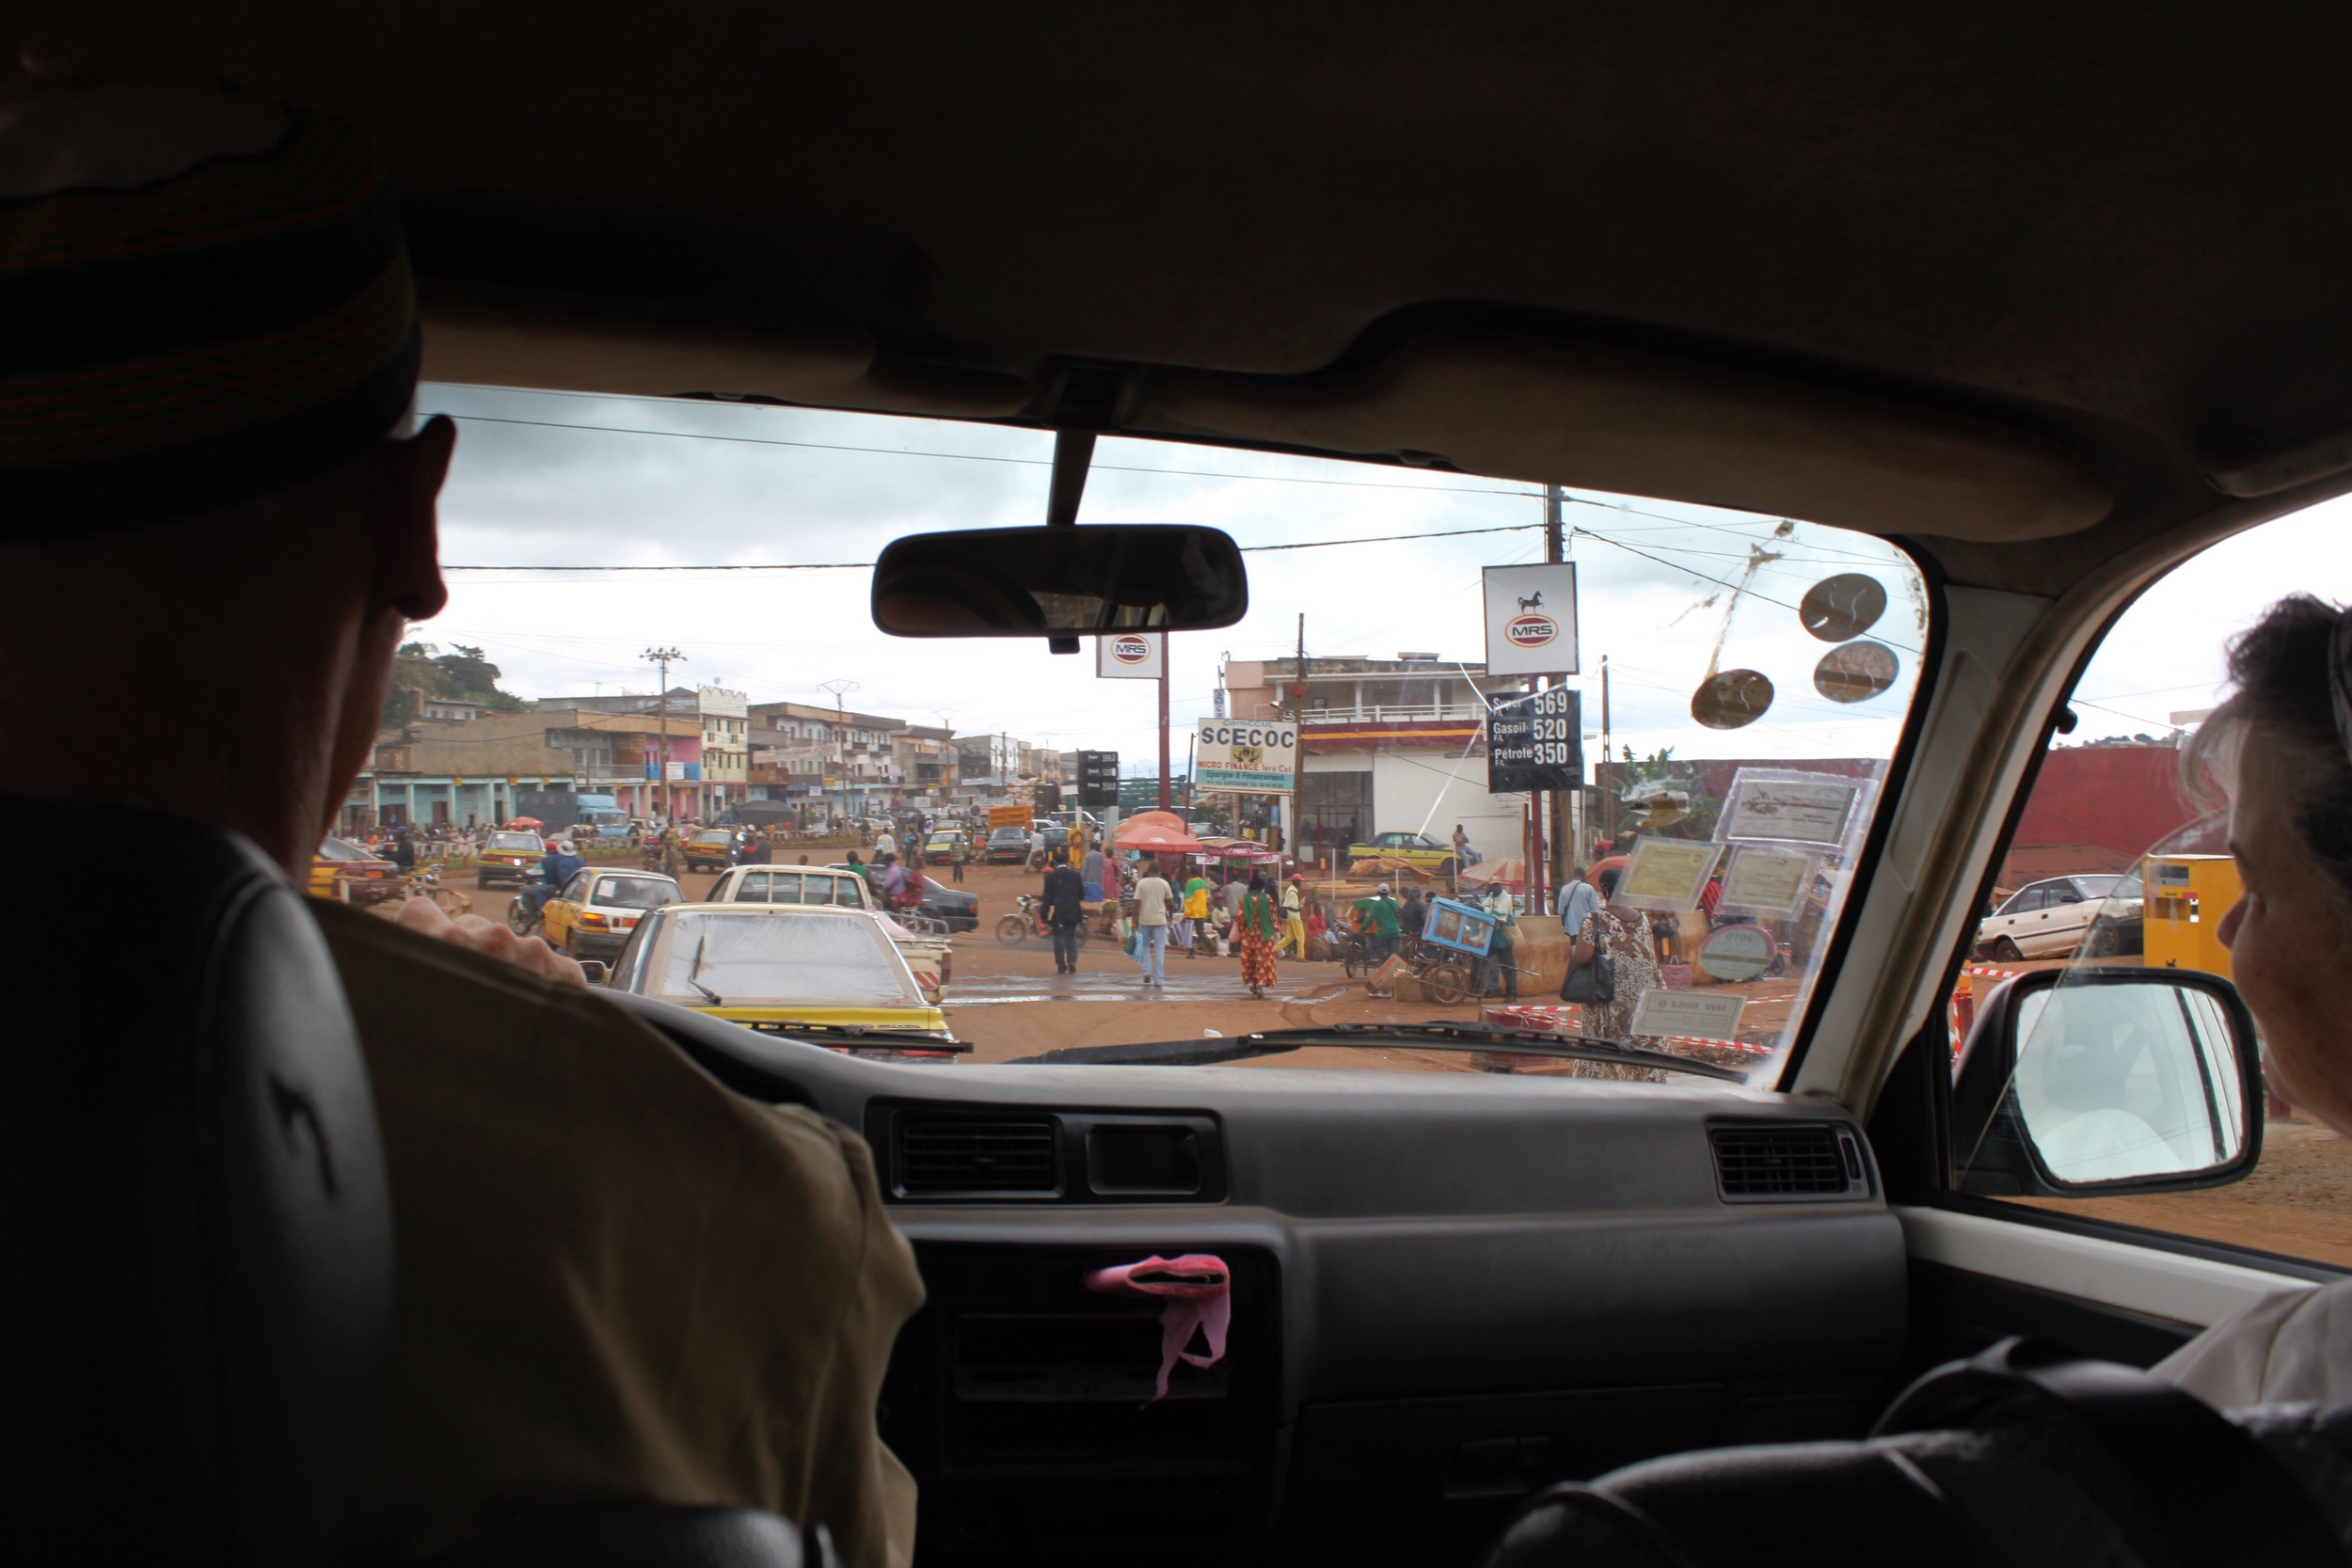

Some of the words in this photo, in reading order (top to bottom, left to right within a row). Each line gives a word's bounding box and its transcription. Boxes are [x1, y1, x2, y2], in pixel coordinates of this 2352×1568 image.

[1512, 625, 1552, 637] MRS
[1116, 643, 1146, 654] MRS
[1534, 691, 1567, 715] 569
[1201, 727, 1295, 749] SCECOC
[1493, 722, 1526, 735] Gasoil
[1533, 719, 1566, 740] 520
[1534, 742, 1567, 765] 350
[1198, 760, 1222, 769] MICRO
[1225, 762, 1259, 771] FINANCE
